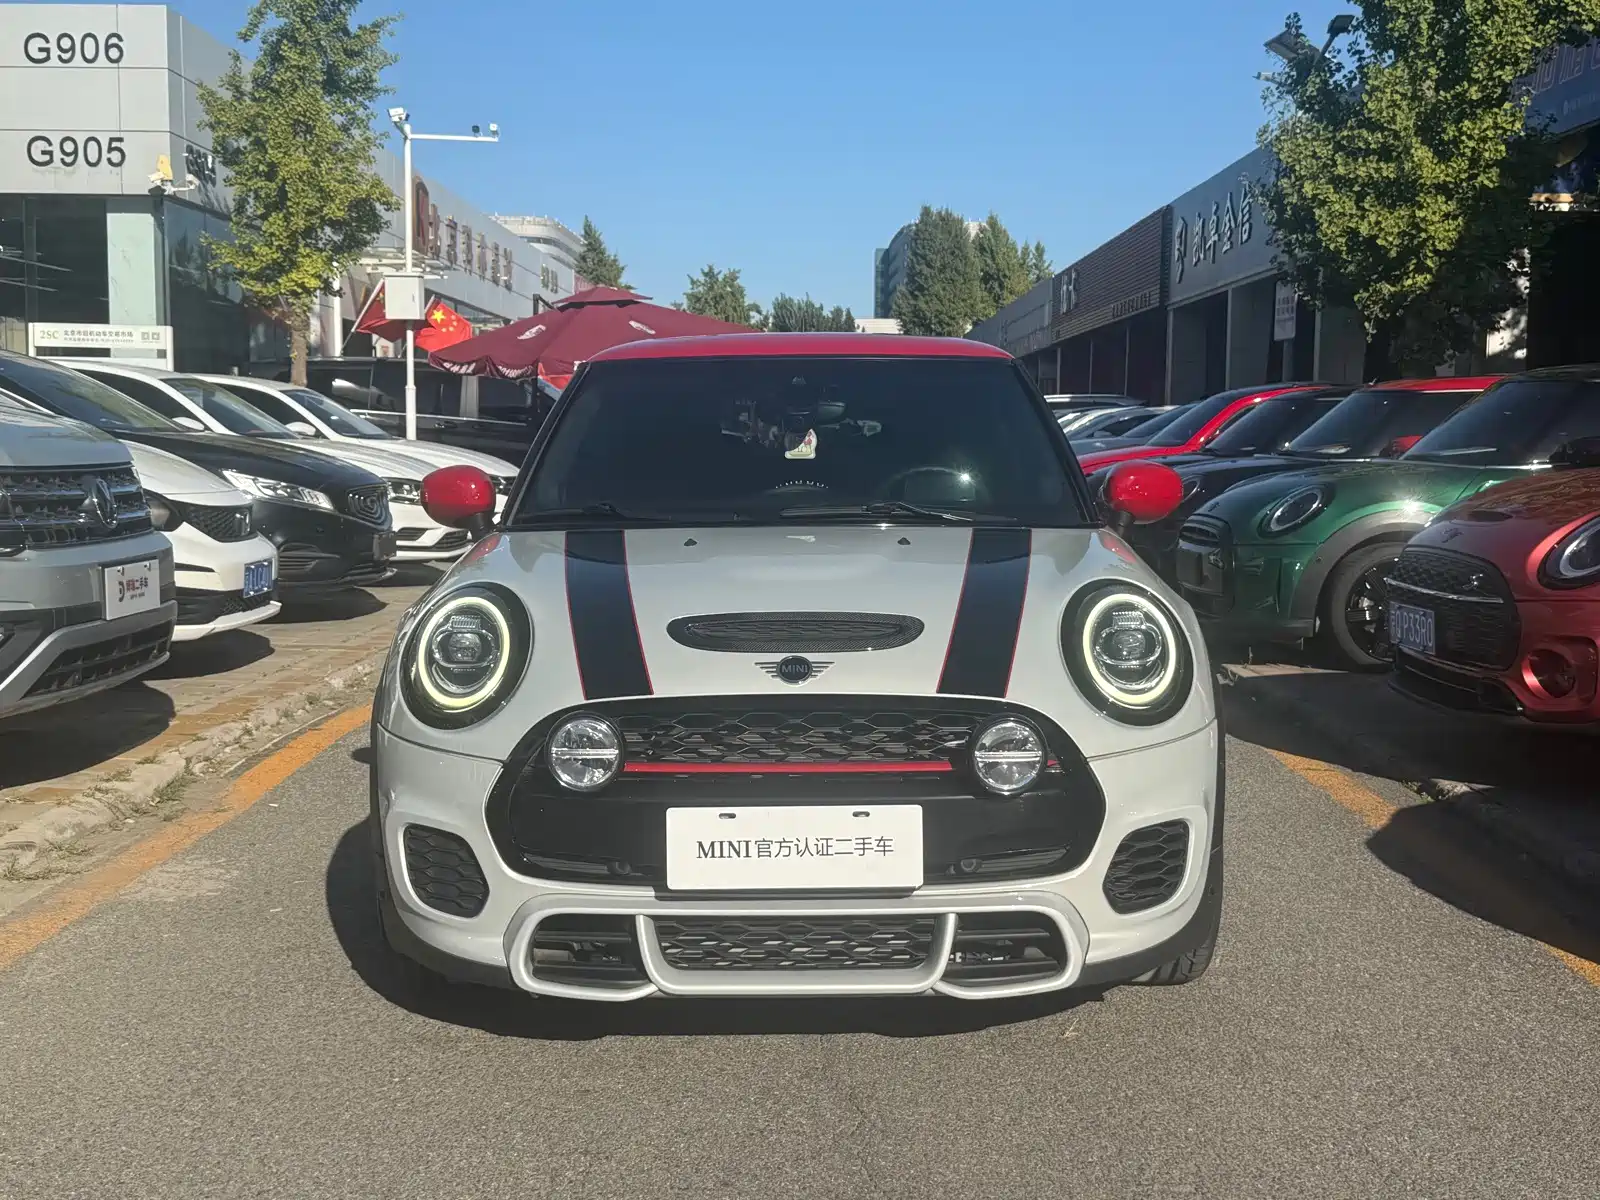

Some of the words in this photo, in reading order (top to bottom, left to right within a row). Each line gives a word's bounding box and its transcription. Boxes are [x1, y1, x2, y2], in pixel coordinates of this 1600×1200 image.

[24, 32, 124, 64] G906
[27, 136, 126, 168] G905
[40, 330, 59, 340] 2SC
[781, 664, 809, 674] MINI
